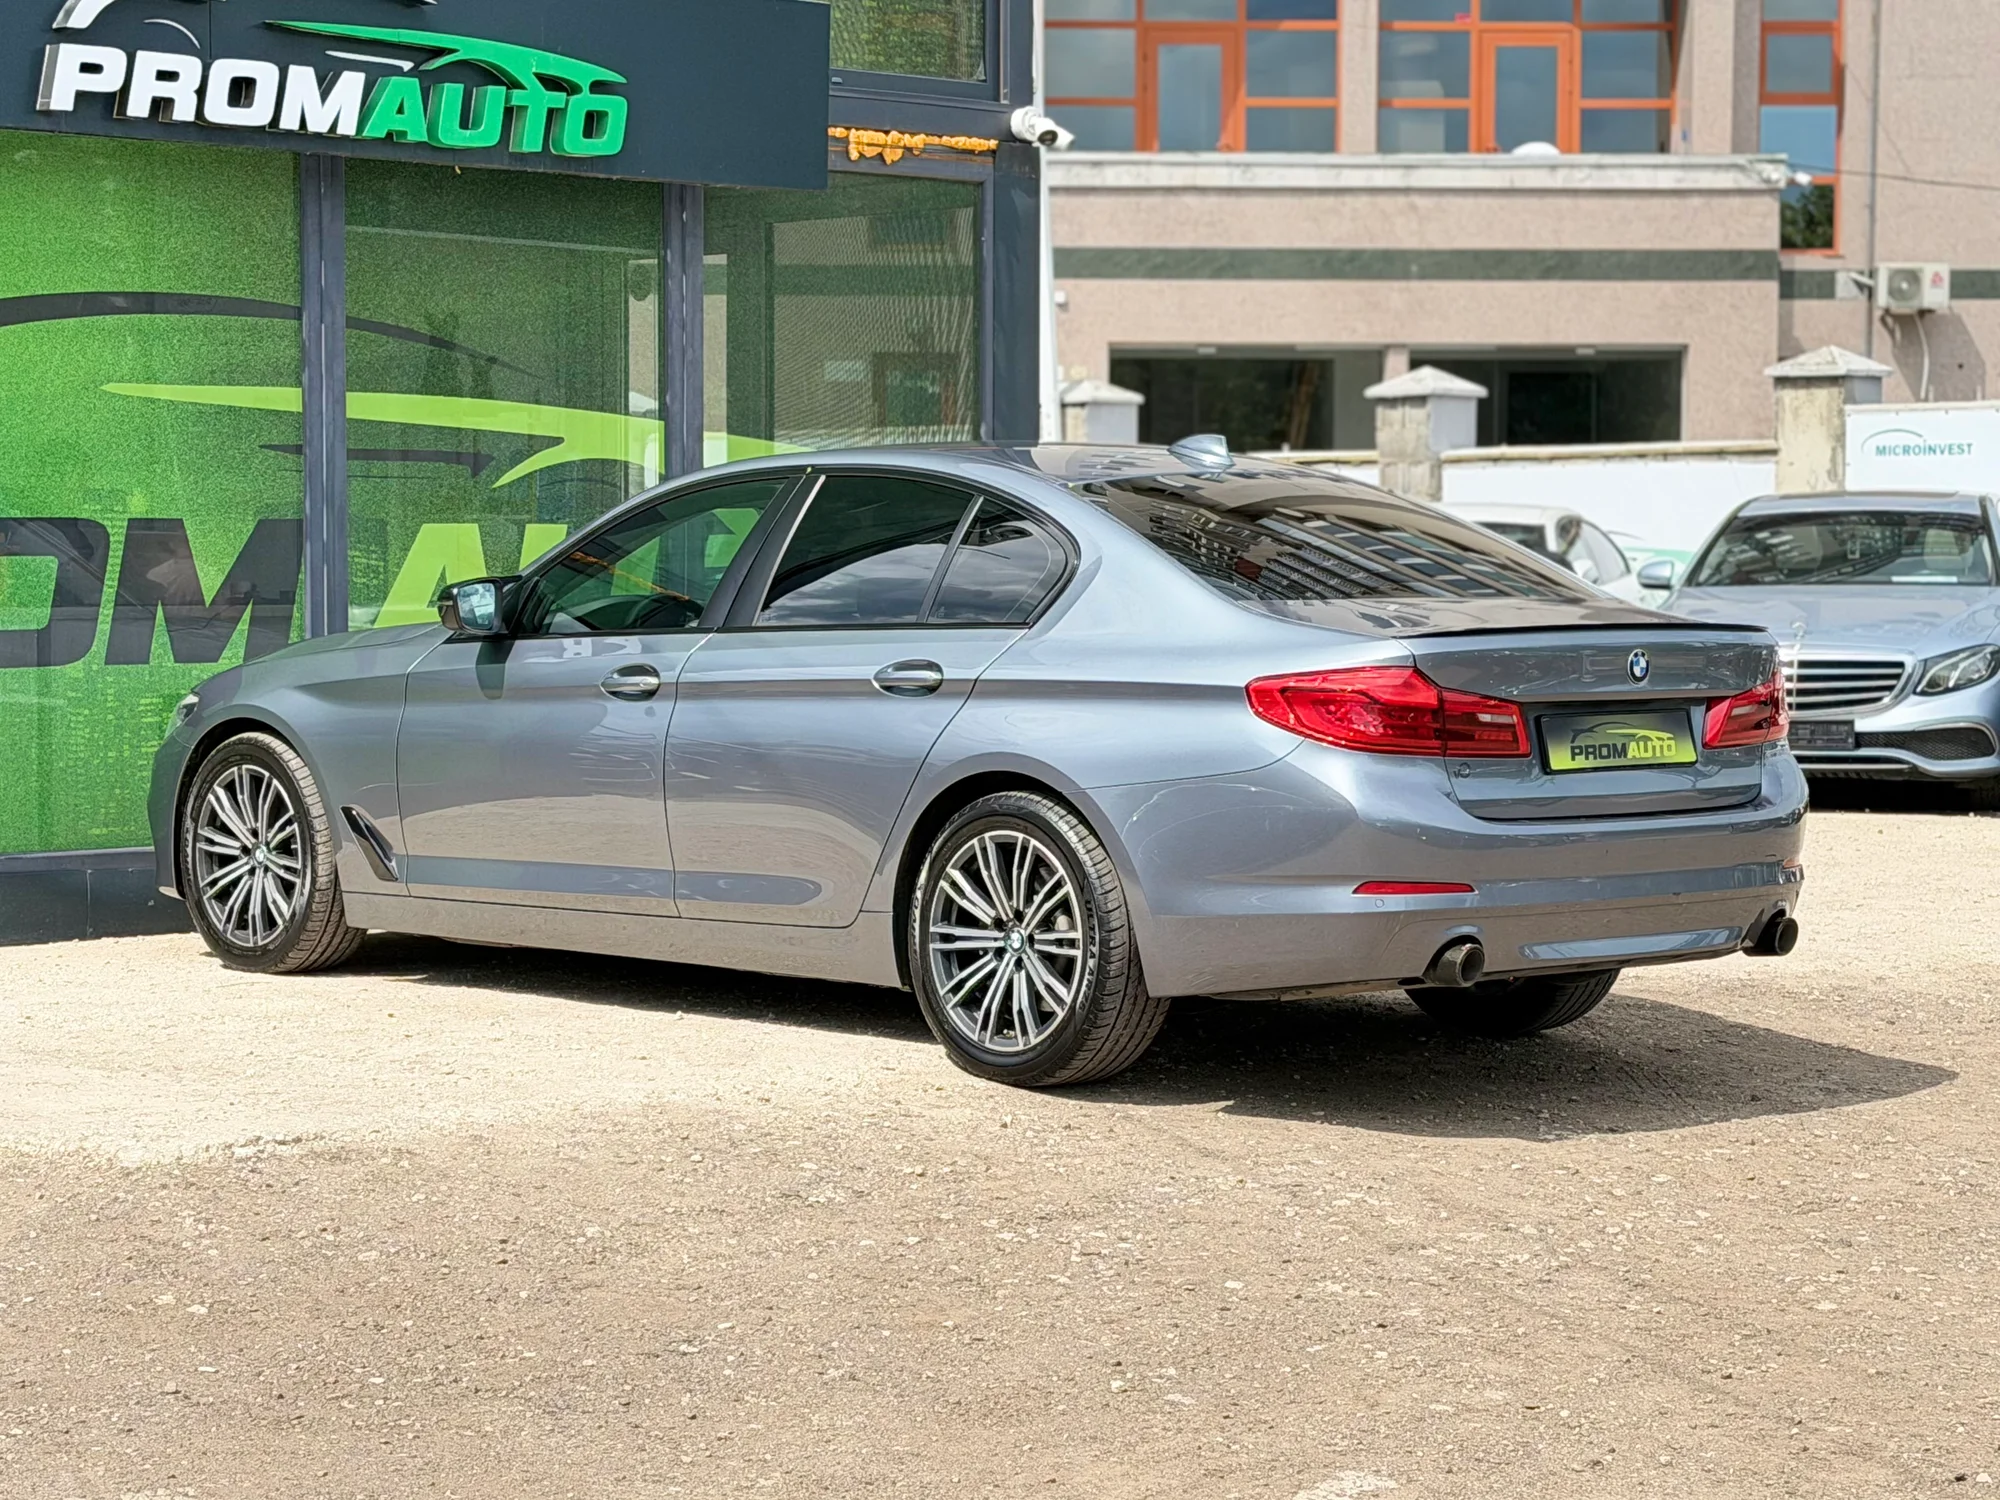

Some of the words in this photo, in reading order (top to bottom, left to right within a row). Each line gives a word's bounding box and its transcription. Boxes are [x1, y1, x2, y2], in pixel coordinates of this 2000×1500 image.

[38, 43, 628, 157] PROMAUTO
[1571, 740, 1676, 761] PROMAUTO
[1084, 900, 1097, 959] ULTRA
